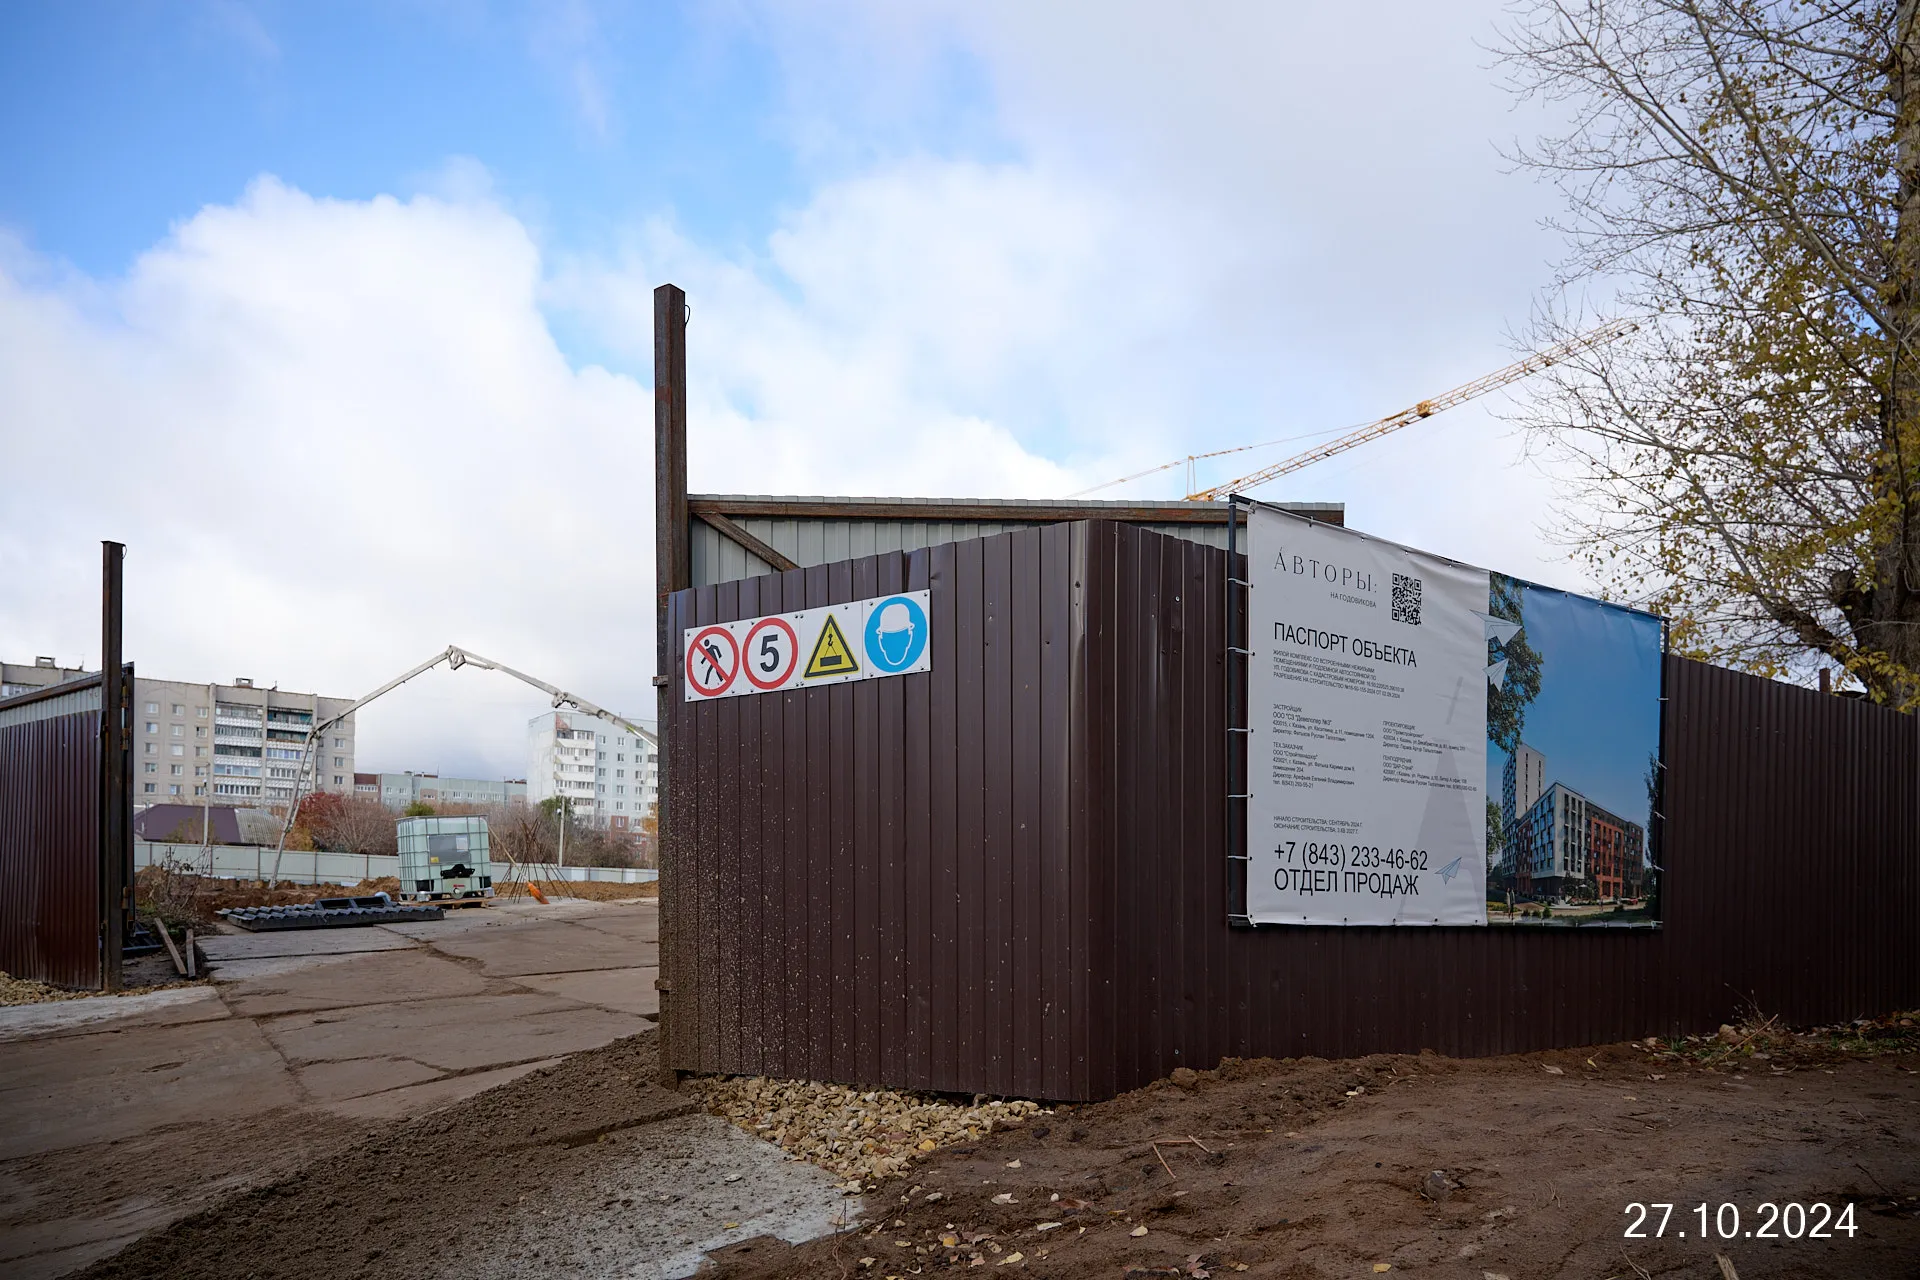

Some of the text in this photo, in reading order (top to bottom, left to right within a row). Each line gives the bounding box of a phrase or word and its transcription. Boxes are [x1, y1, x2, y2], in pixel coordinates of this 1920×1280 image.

[1330, 592, 1376, 608] НА ГОДОВИКОВА
[760, 634, 779, 673] 5
[1274, 622, 1417, 668] ПАСПОРТ ОБЪЕКТА
[1273, 704, 1302, 712] ЗАСТРОЙЩИК
[1274, 842, 1428, 871] +7 (843) 233-46-62
[1274, 868, 1419, 898] ОТДЕЛ ПРОДАЖ
